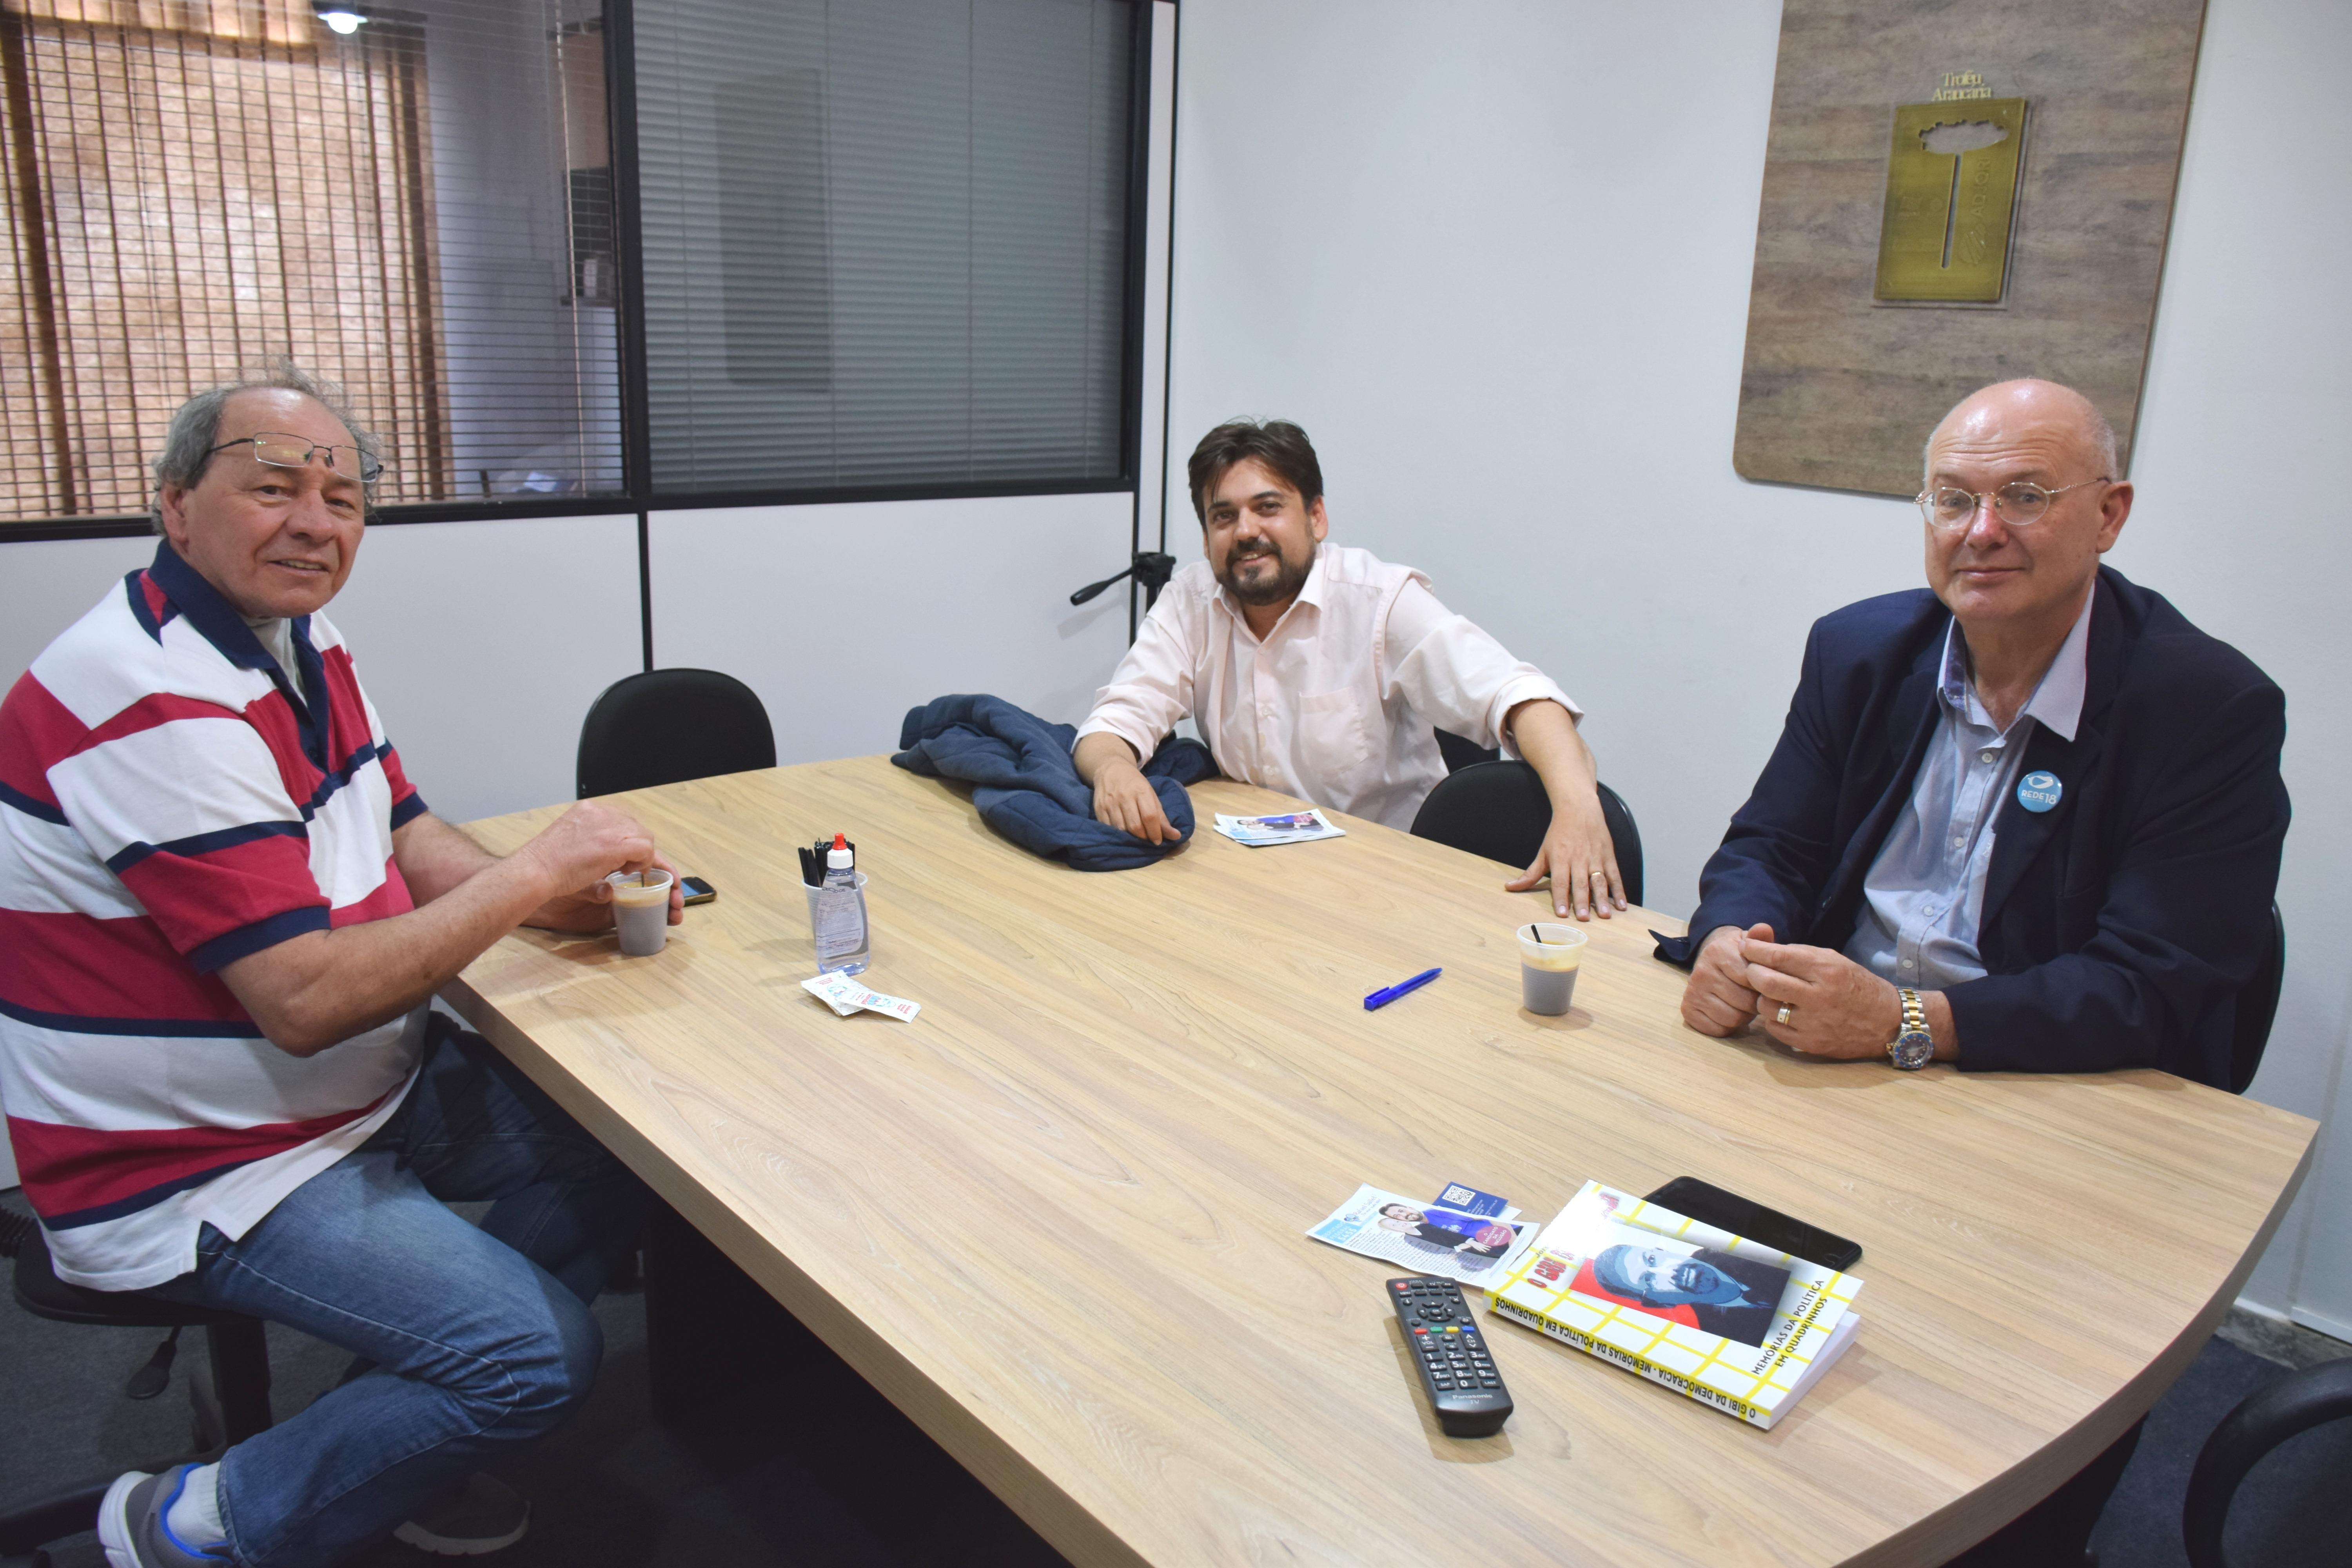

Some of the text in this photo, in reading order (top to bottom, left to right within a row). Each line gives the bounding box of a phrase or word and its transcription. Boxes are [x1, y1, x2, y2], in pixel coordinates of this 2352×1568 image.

[1942, 69, 1982, 86] Troféu
[1483, 1227, 1498, 1244] CANDIDATO
[1494, 1230, 1507, 1245] INCLUSÃO
[1528, 1278, 1547, 1288] O
[1495, 1297, 1544, 1326] QUADRINHOS
[1546, 1319, 1557, 1331] EM
[1752, 1280, 1824, 1374] MEMÓRIAS DA POLÍTICA
[1775, 1297, 1828, 1367] EM QUADRINHOS
[1559, 1324, 1594, 1348] POLÍTICA
[1597, 1342, 1606, 1354] DA
[1609, 1347, 1651, 1373] MEMÓRIAS
[1659, 1368, 1713, 1400] DEMOCRACIA
[1716, 1396, 1727, 1406] DA
[1729, 1399, 1747, 1414] GIBI
[1749, 1408, 1756, 1418] O
